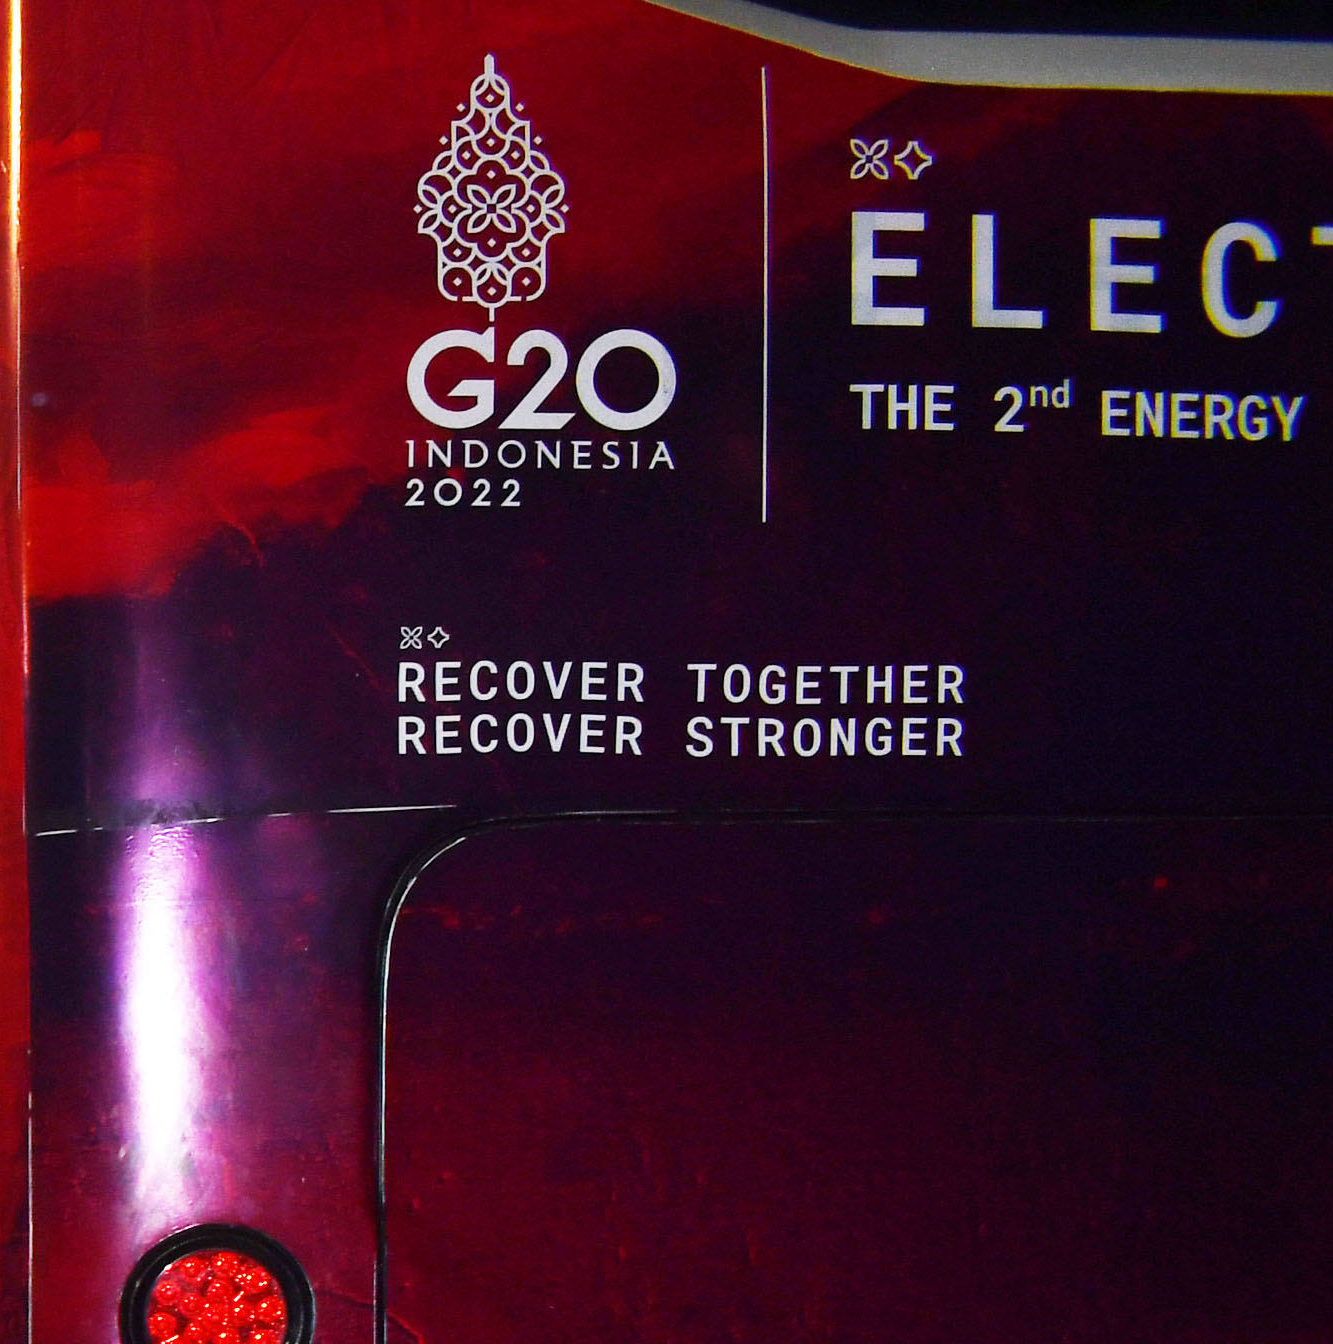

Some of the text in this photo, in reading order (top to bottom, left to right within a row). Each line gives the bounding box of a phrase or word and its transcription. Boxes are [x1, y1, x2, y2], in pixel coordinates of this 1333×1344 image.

[852, 212, 1333, 337] ELEC
[407, 327, 676, 430] G20
[850, 379, 1303, 441] THE 2nd ENERGY
[406, 440, 675, 469] INDONESIA
[405, 479, 521, 506] 2022
[398, 660, 965, 705] RECOVER TOGETHER
[398, 713, 963, 757] RECOVER STRONGER
